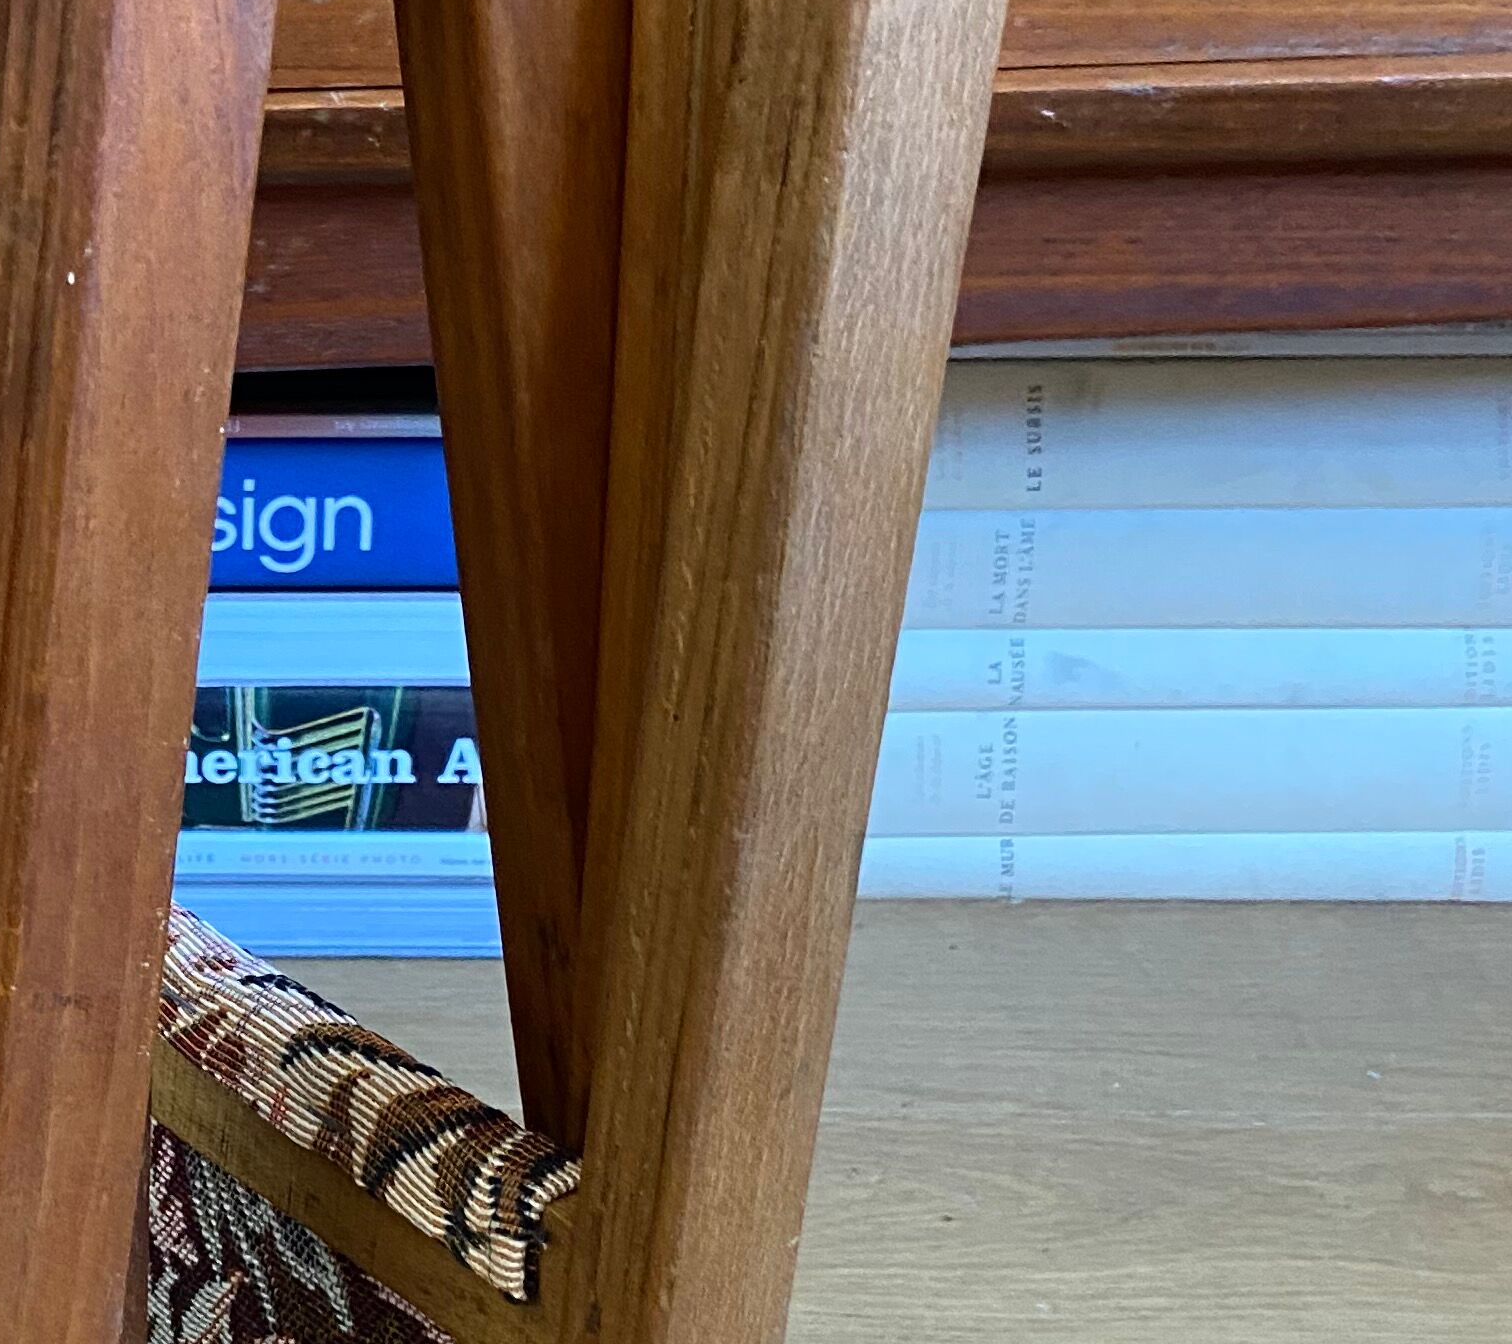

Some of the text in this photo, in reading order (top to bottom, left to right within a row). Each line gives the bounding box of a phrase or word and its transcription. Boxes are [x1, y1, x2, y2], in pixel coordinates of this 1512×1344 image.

[211, 479, 373, 573] sign
[989, 529, 1010, 615] LA MORT
[988, 660, 1003, 685] LA
